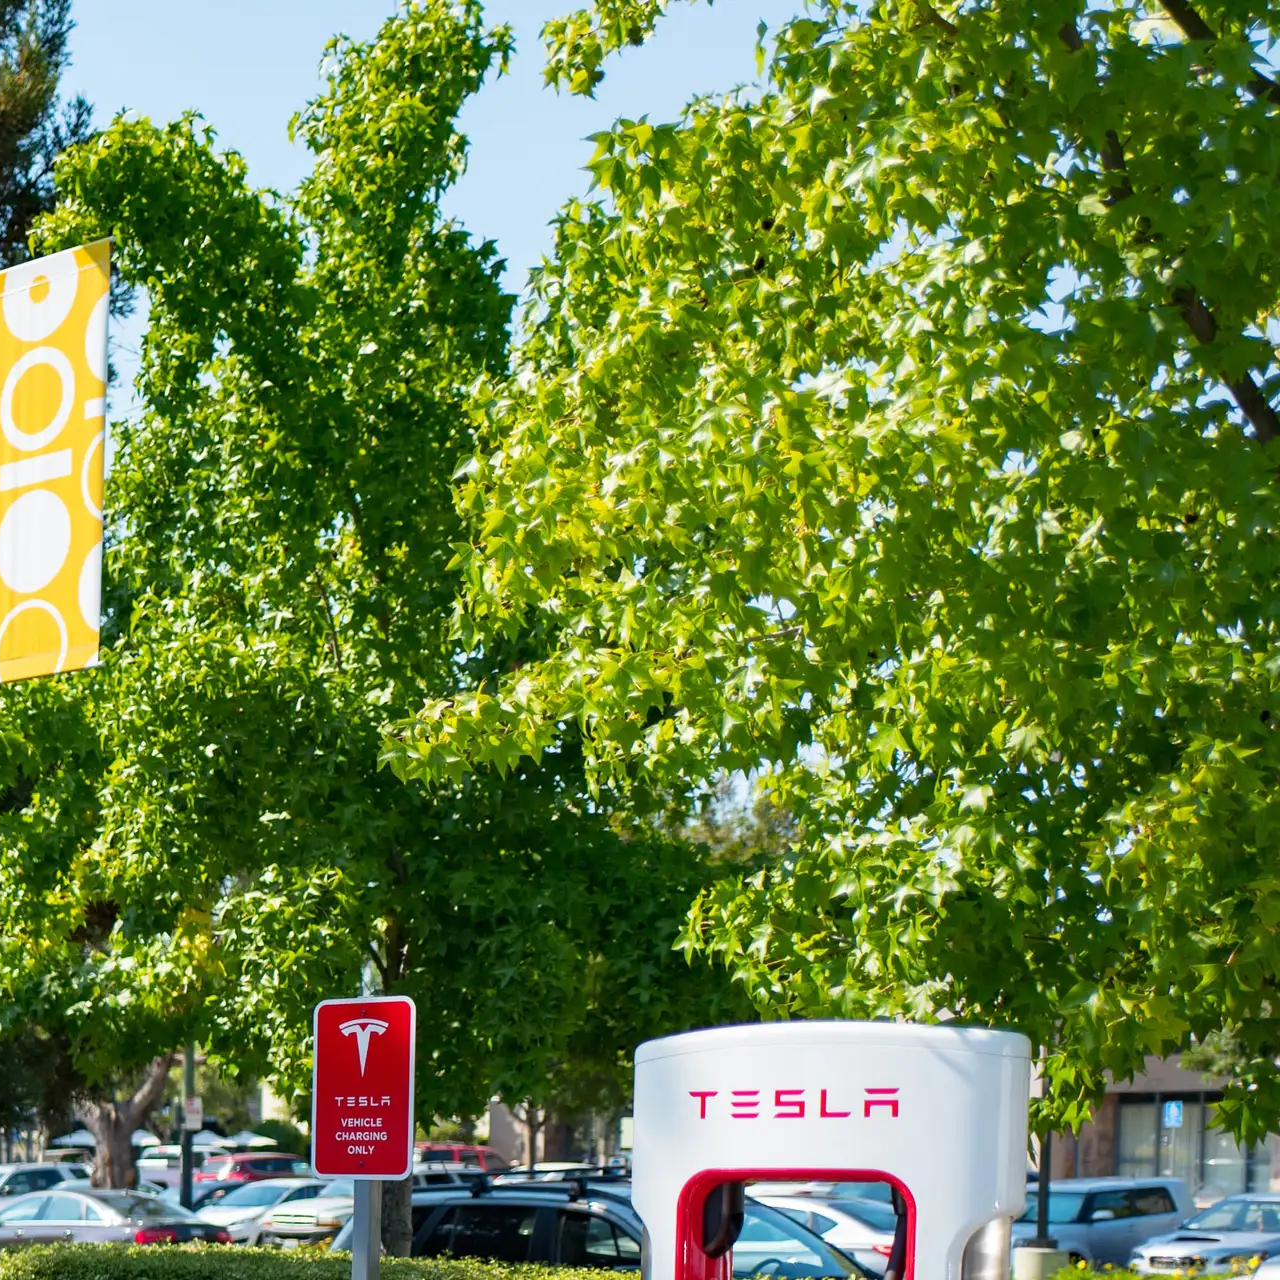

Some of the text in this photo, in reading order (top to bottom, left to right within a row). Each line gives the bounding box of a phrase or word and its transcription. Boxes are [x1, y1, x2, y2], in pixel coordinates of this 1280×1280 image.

[335, 1096, 391, 1107] TESLA
[688, 1088, 900, 1119] TESLA
[341, 1117, 383, 1128] VEHICLE
[335, 1131, 388, 1142] CHARGING
[347, 1145, 375, 1155] ONLY
